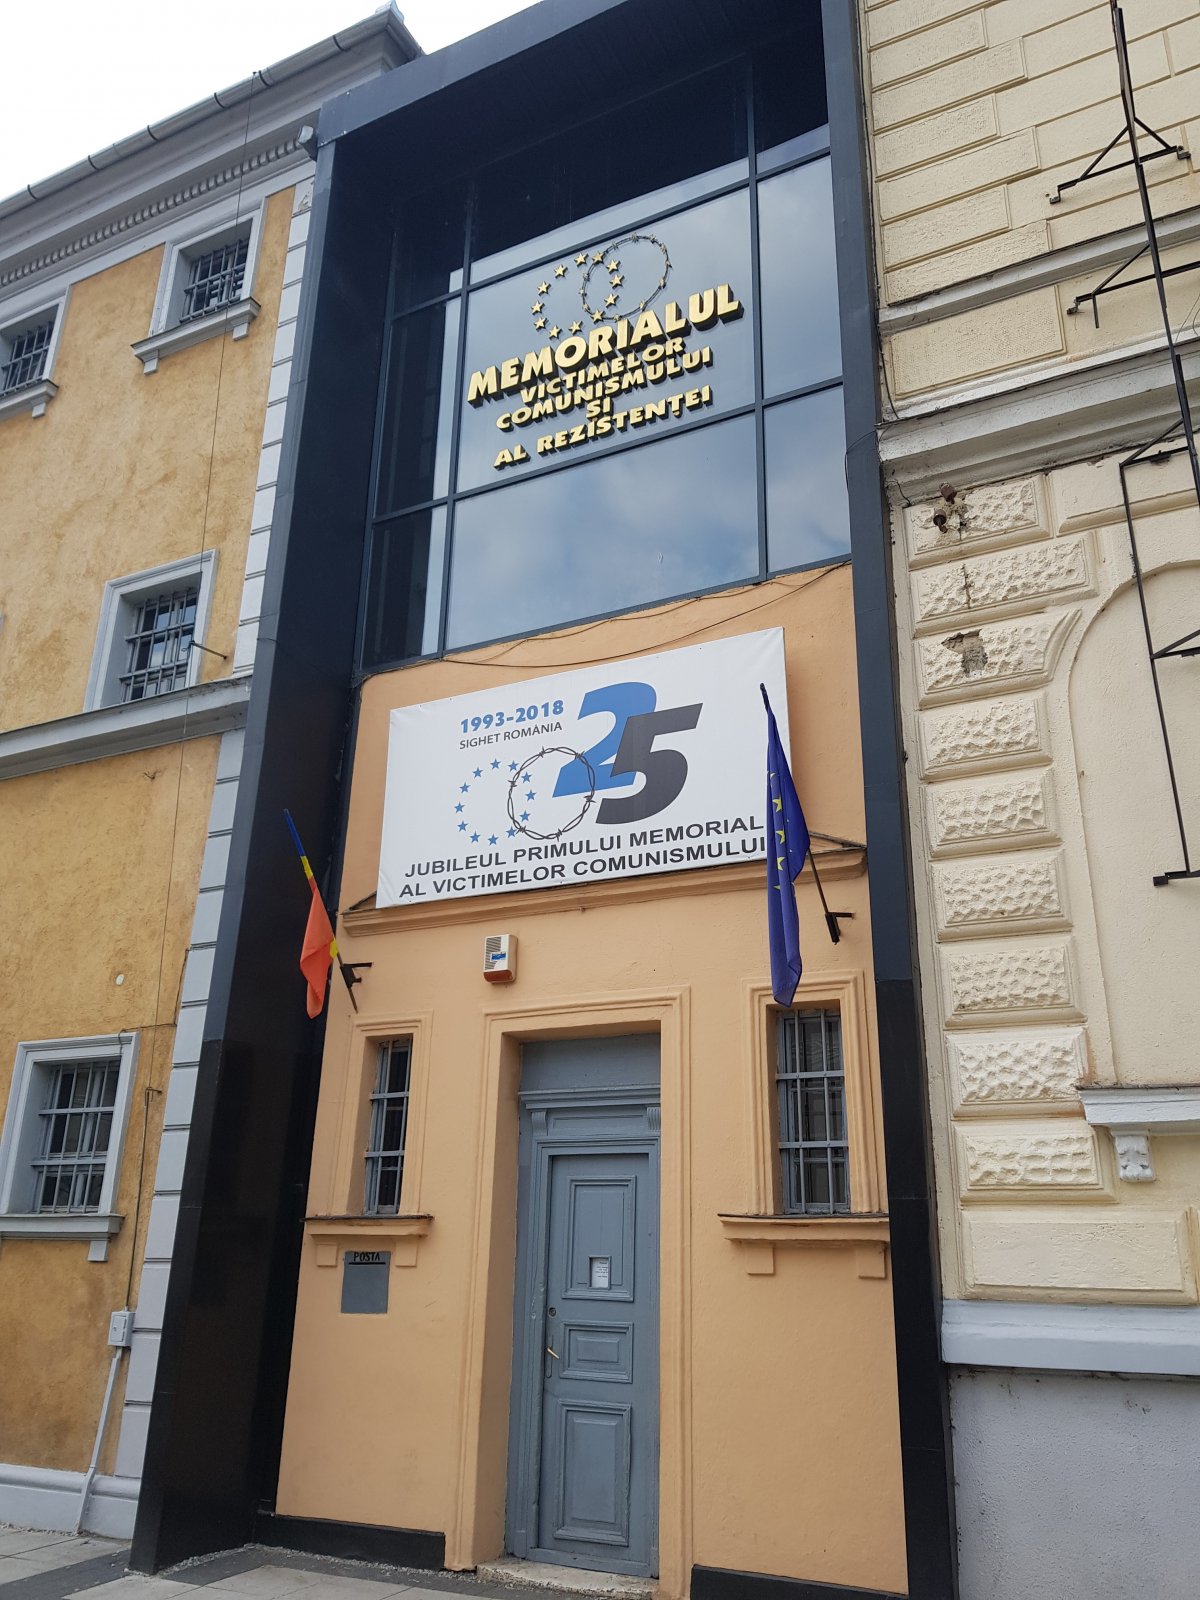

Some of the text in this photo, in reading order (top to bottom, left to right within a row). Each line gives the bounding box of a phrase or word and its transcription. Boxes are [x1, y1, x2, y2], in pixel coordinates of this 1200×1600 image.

[467, 283, 742, 403] MEMORIALUL
[519, 337, 686, 403] VICTIMELOR
[496, 346, 712, 430] COMUNISMULUI
[493, 444, 528, 468] AL
[459, 733, 501, 749] SIGHET
[460, 699, 564, 733] 1993-2018
[552, 681, 703, 825] 25
[399, 836, 766, 898] AL VICTIMELOR COMUNISMULUI
[404, 815, 764, 878] JUBILEUL PRIMULUI MEMORIAL
